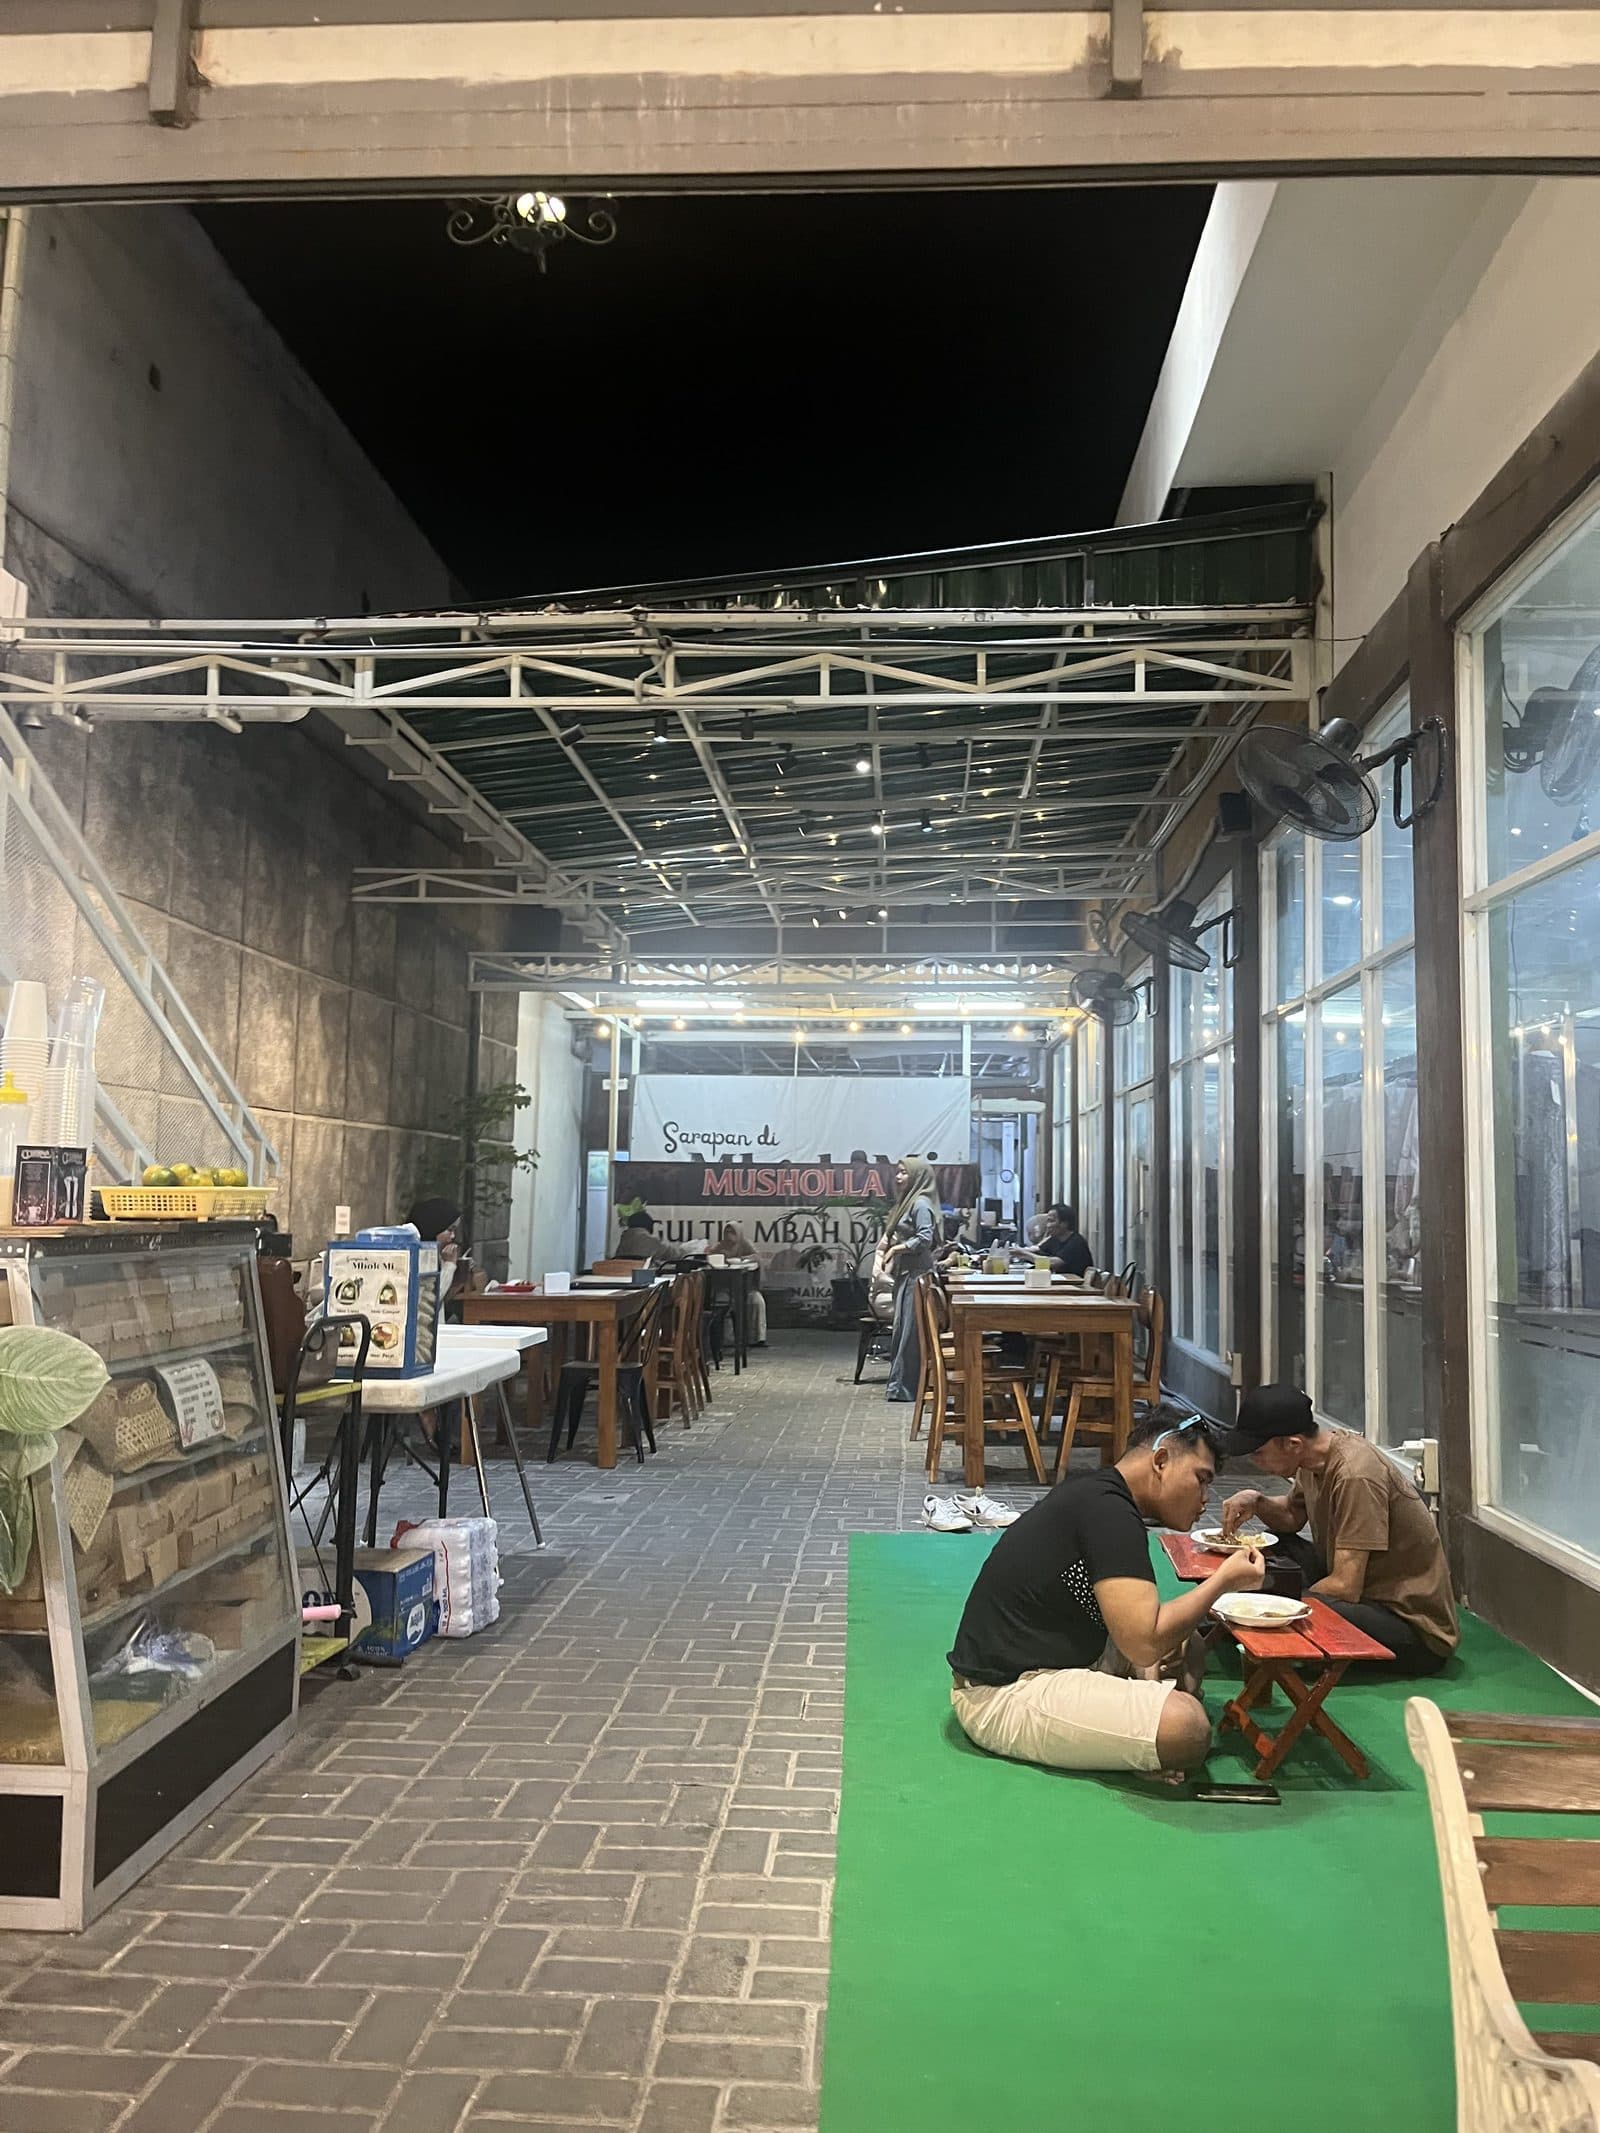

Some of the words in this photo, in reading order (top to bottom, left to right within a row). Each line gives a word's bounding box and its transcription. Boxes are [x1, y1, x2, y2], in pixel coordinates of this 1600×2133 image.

[662, 1121, 752, 1156] Sarapan
[757, 1124, 780, 1146] di
[702, 1168, 886, 1198] MUSHOLLA
[754, 1219, 839, 1244] MBAH
